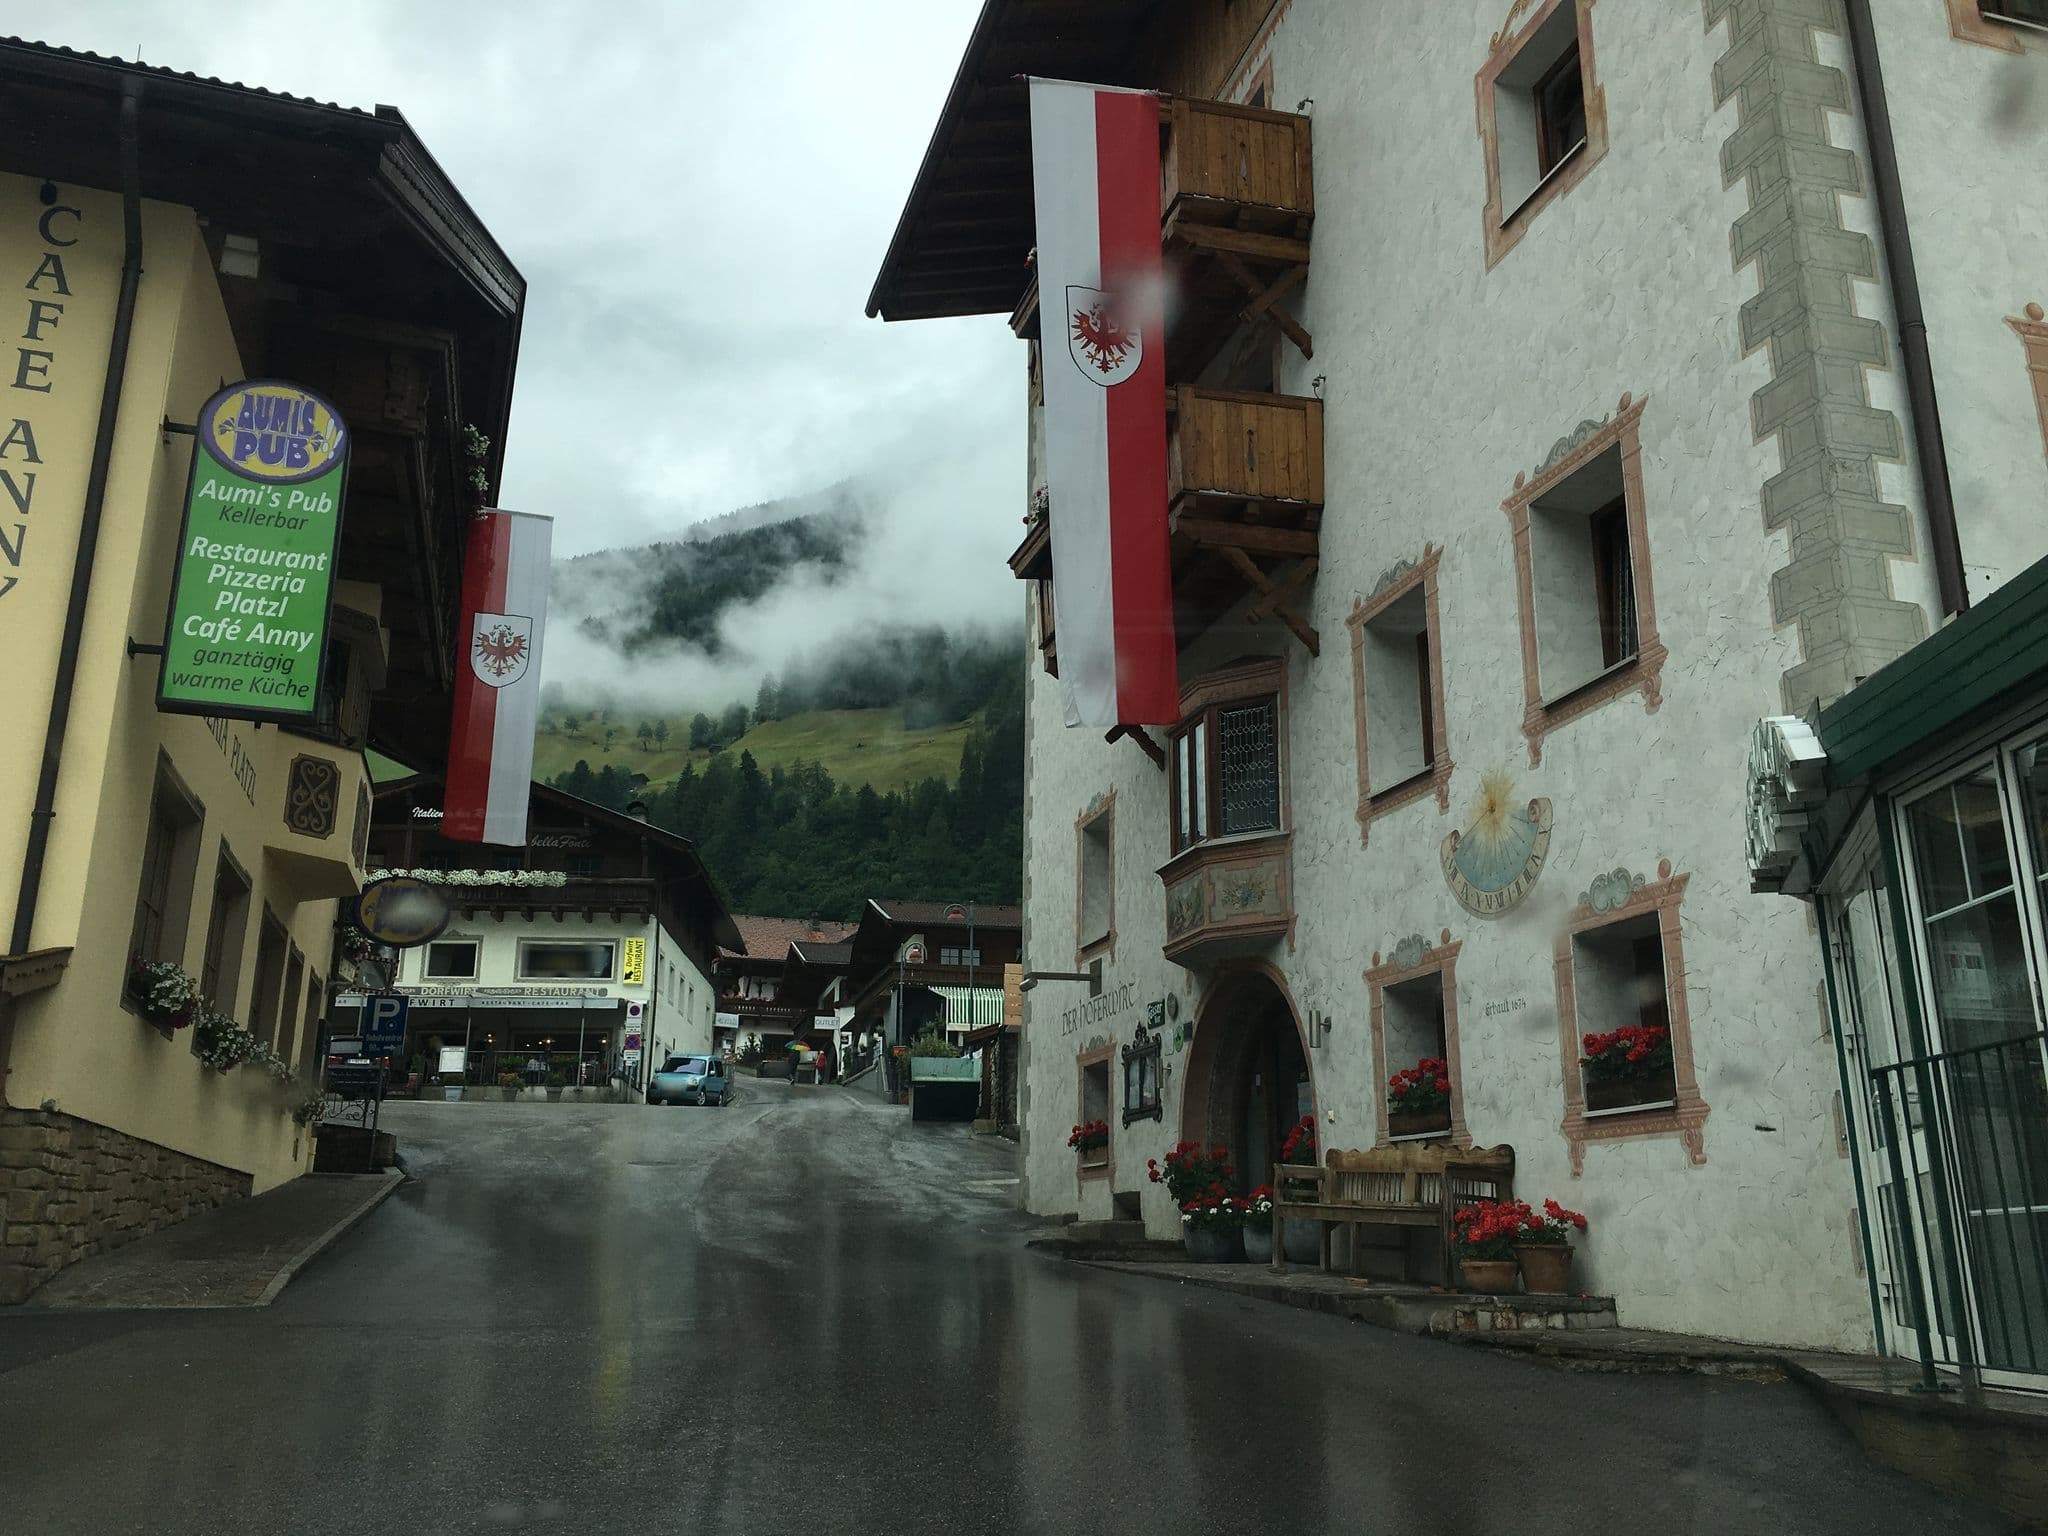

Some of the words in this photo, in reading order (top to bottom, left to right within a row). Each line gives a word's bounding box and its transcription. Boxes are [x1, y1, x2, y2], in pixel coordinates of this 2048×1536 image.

[10, 206, 82, 394] CAFE
[232, 430, 310, 469] PUB
[198, 479, 282, 508] Aumi's
[287, 490, 332, 513] Pub
[218, 505, 309, 531] Kellerbar
[189, 536, 328, 572] Restaurant
[207, 563, 306, 594] Pizzeria
[214, 590, 289, 618] Platzl
[183, 614, 242, 644] Café
[245, 622, 315, 652] Anny
[192, 648, 296, 675] ganztägig
[171, 671, 244, 692] warme
[249, 676, 311, 699] Küche
[634, 940, 643, 982] RESTAURANT
[420, 986, 477, 996] DORFWIRT
[524, 987, 599, 996] RESTAURANT
[372, 998, 401, 1031] P
[1062, 1008, 1077, 1036] DER
